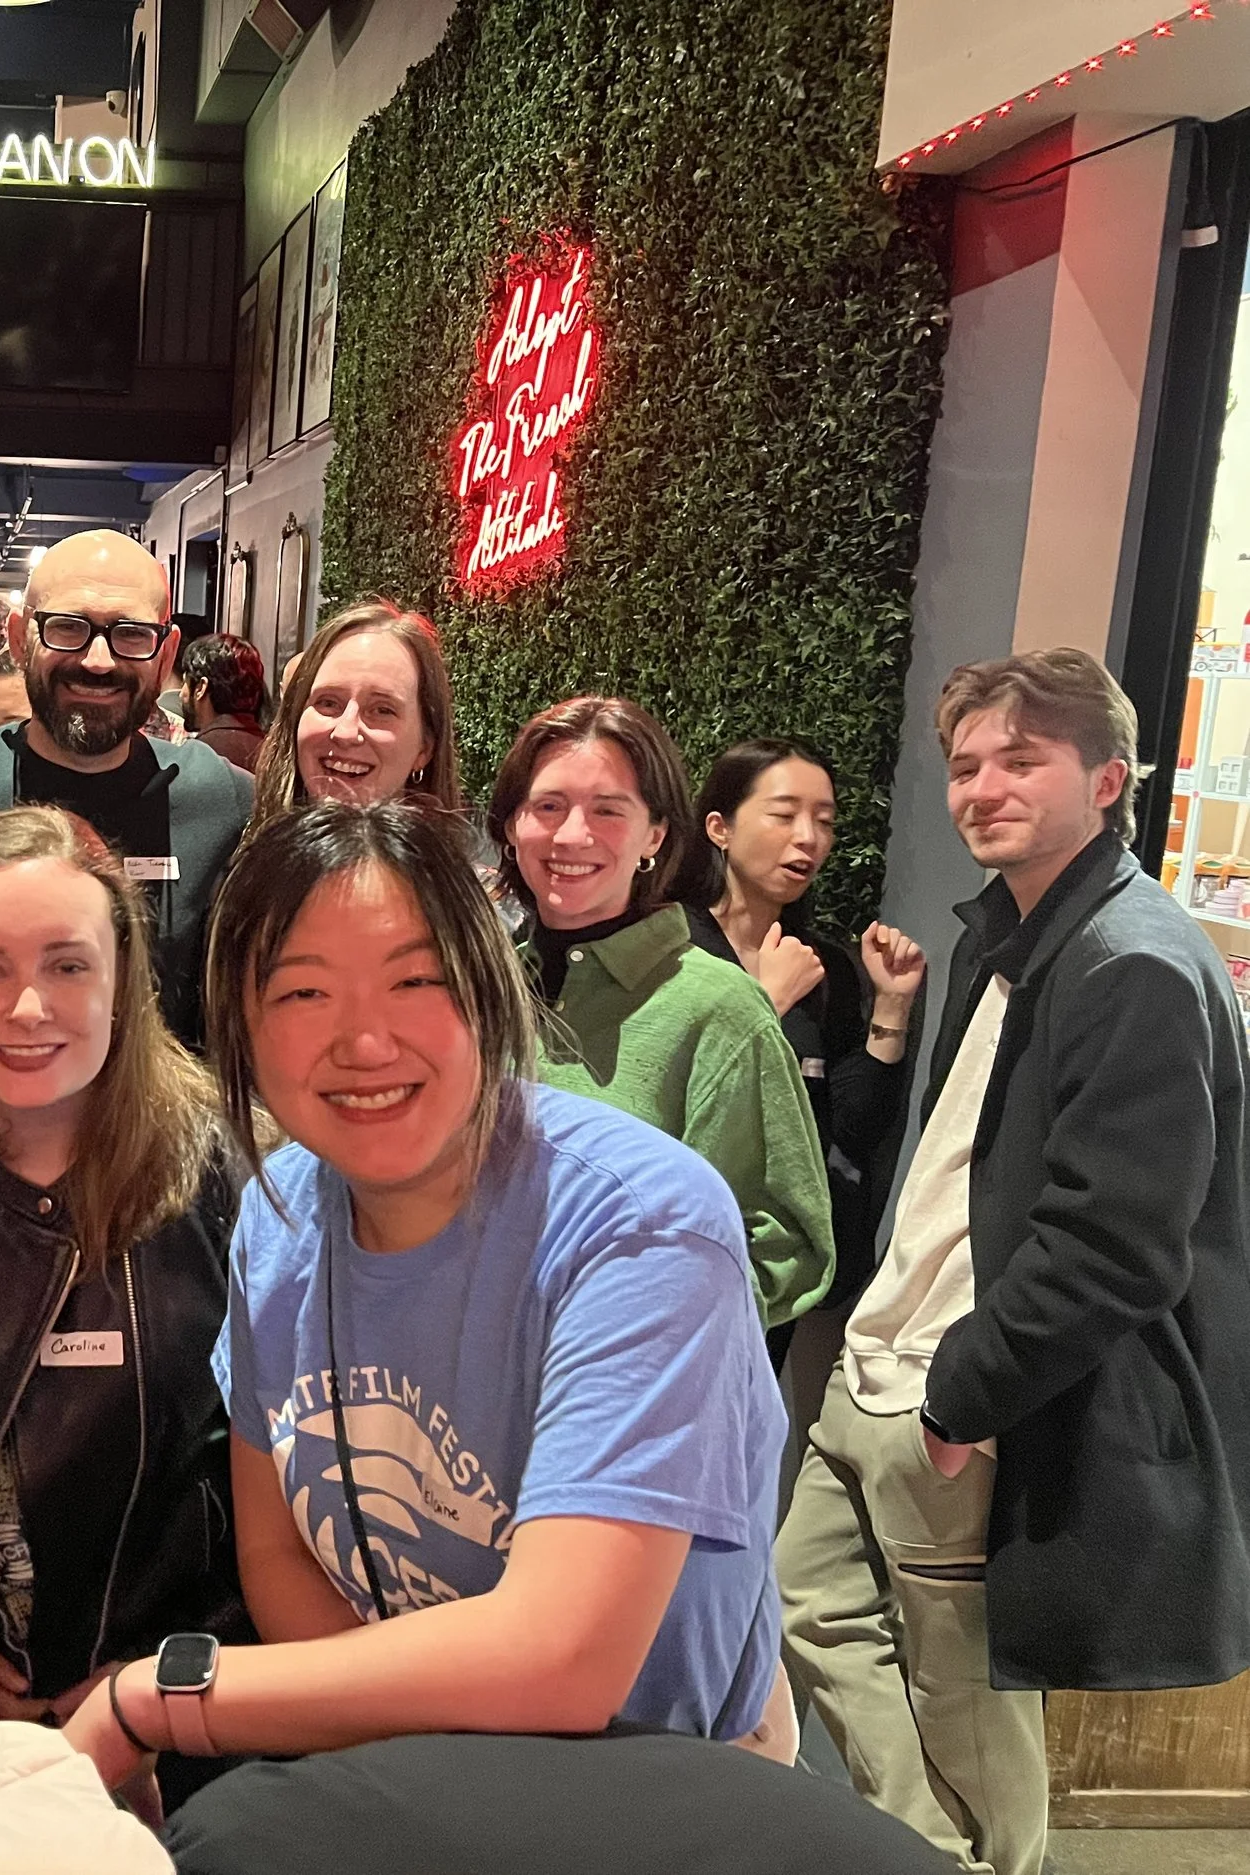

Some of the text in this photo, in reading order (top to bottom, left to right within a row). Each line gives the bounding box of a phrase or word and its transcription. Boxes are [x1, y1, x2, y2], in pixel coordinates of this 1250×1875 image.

[459, 329, 594, 496] The French
[466, 470, 564, 580] Attitude
[51, 1338, 106, 1355] Caroline
[348, 1366, 422, 1418] FILM
